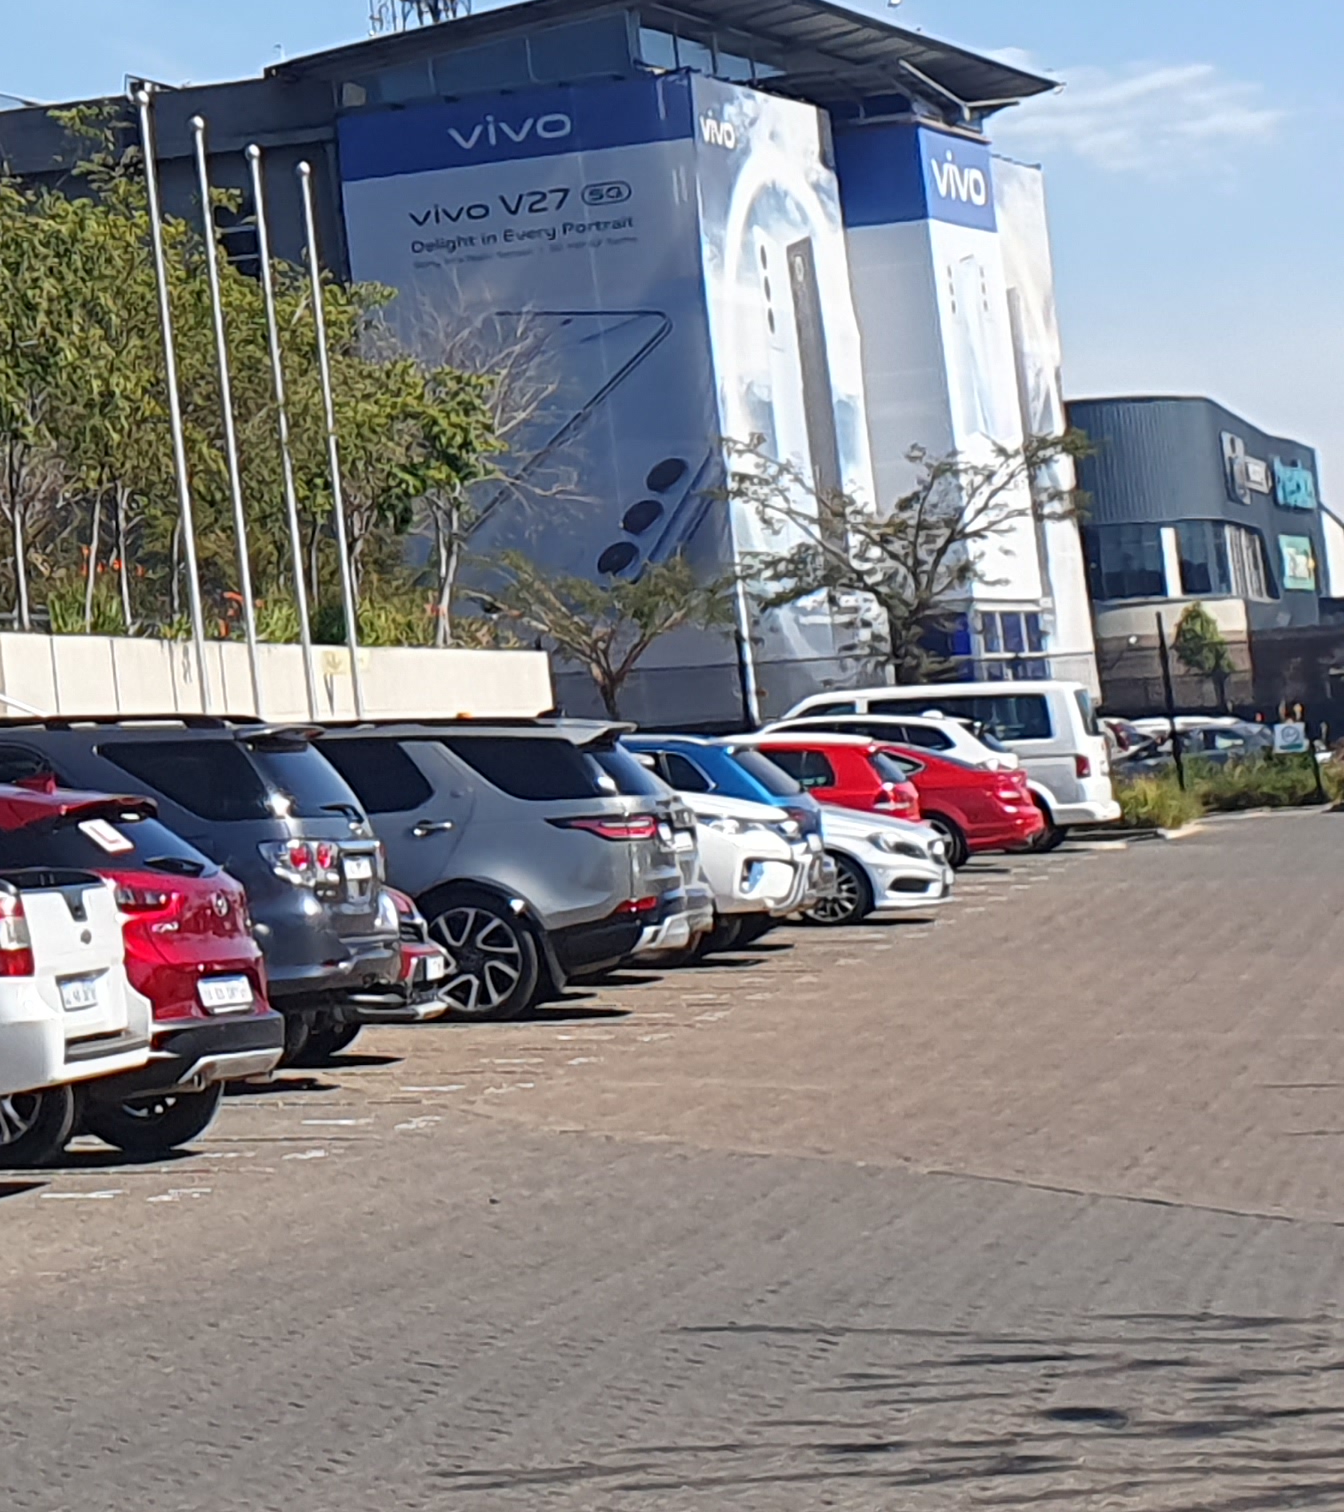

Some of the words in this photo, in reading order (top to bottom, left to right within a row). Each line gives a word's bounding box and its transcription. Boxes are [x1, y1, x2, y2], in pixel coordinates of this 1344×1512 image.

[447, 114, 572, 150] vivo
[699, 109, 736, 150] vivo
[930, 149, 986, 206] vivo
[408, 203, 490, 227] vivo
[498, 188, 571, 216] V27
[411, 232, 477, 254] Delight
[480, 232, 498, 245] in
[502, 226, 557, 243] Every
[561, 216, 635, 236] Portrait
